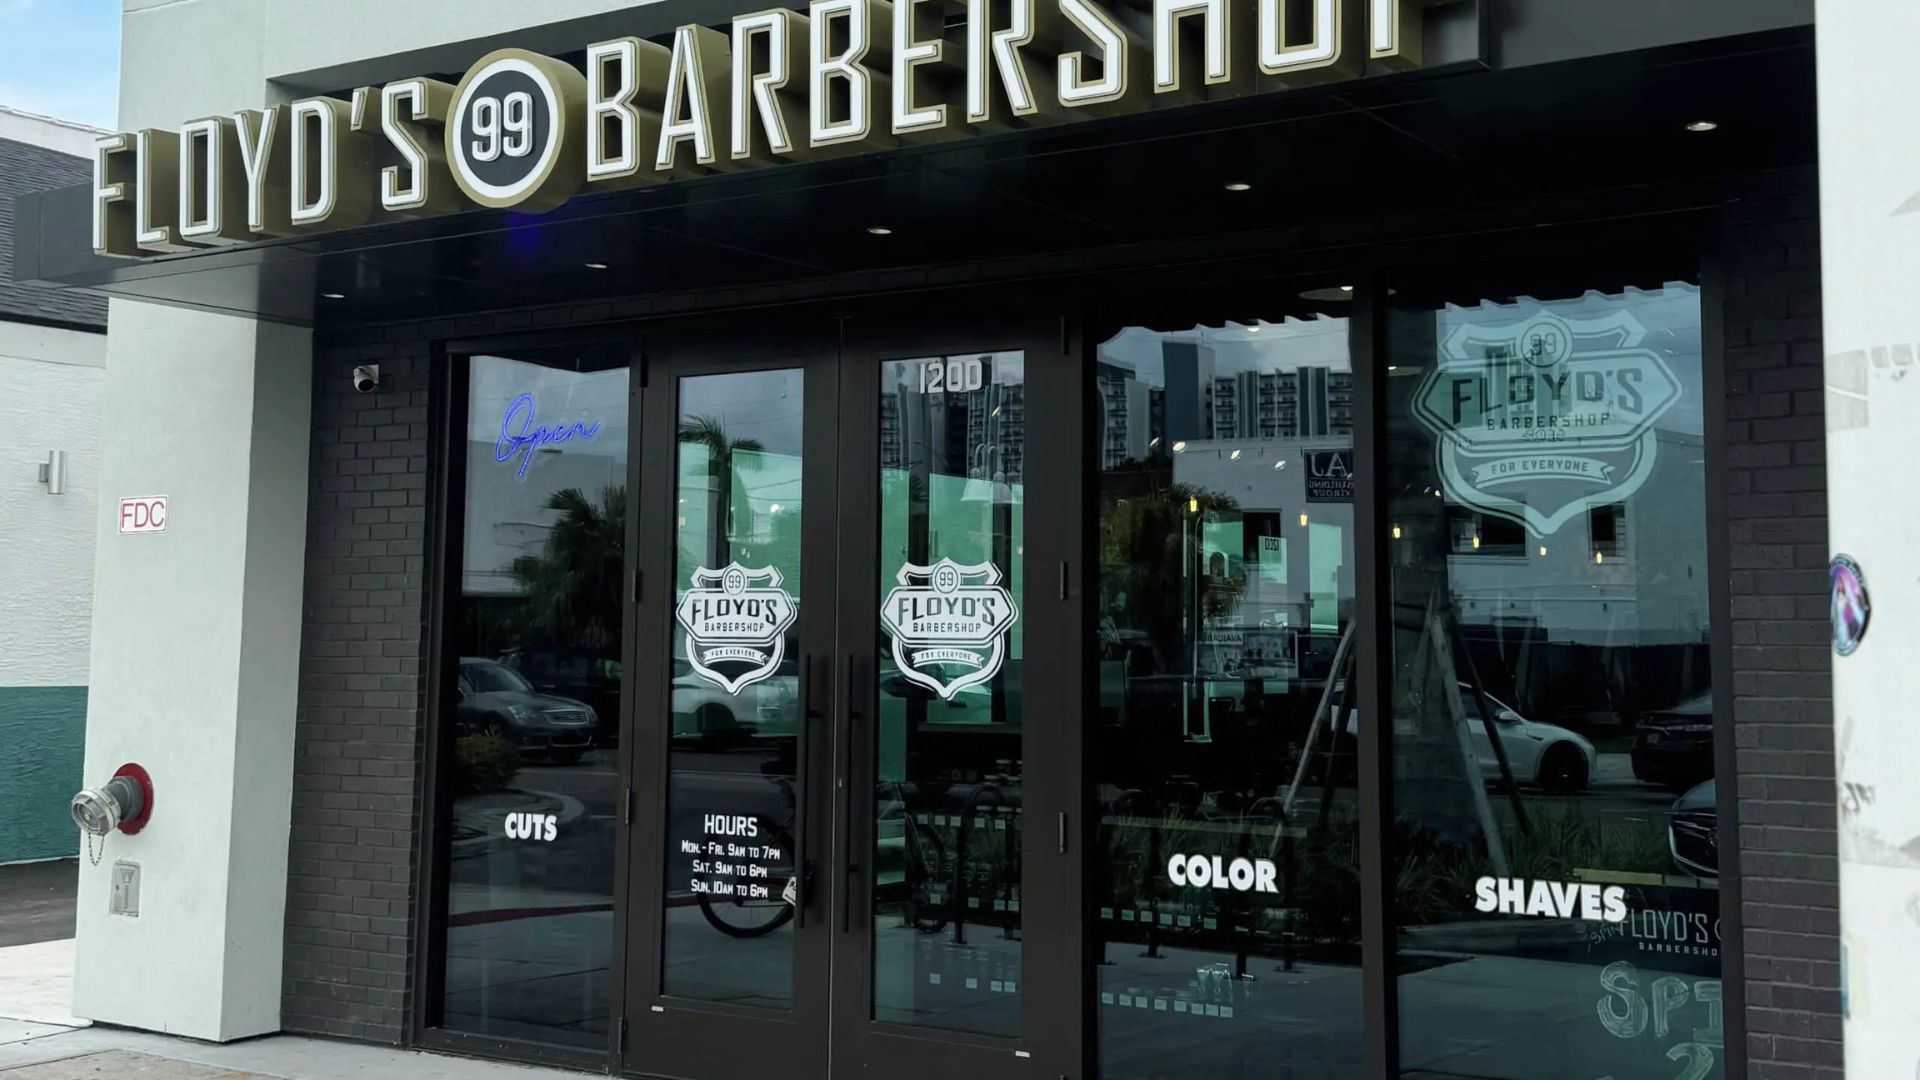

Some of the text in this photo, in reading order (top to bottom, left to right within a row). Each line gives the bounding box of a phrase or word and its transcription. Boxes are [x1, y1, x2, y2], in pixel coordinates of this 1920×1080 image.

[93, 76, 430, 256] FLOYD'S
[470, 91, 533, 163] 99
[919, 358, 983, 395] 1200
[1451, 367, 1643, 426] FLOYD'S
[1486, 412, 1610, 431] BARBERSHOP
[495, 392, 603, 479] Open
[1490, 459, 1590, 475] FOR EVERYONE
[121, 499, 165, 529] FDC
[728, 574, 741, 589] 99
[939, 571, 954, 587] 99
[691, 598, 777, 627] FLOYD'S
[897, 596, 996, 627] FLOYD'S
[704, 622, 765, 632] BARBERSHOP
[912, 622, 981, 633] BARBERSHOP
[504, 812, 558, 842] CUTS
[704, 813, 758, 837] HOURS
[728, 843, 746, 857] 9AM
[748, 847, 759, 858] TO
[762, 845, 781, 860] 7PM
[715, 861, 733, 876] 9AM
[736, 865, 747, 876] TO
[749, 864, 768, 878] 6PM
[1167, 853, 1280, 894] COLOR
[736, 885, 747, 896] TO
[750, 884, 768, 898] 6PM
[1474, 876, 1627, 923] SHAVES
[1638, 942, 1718, 957] BARBERSHO
